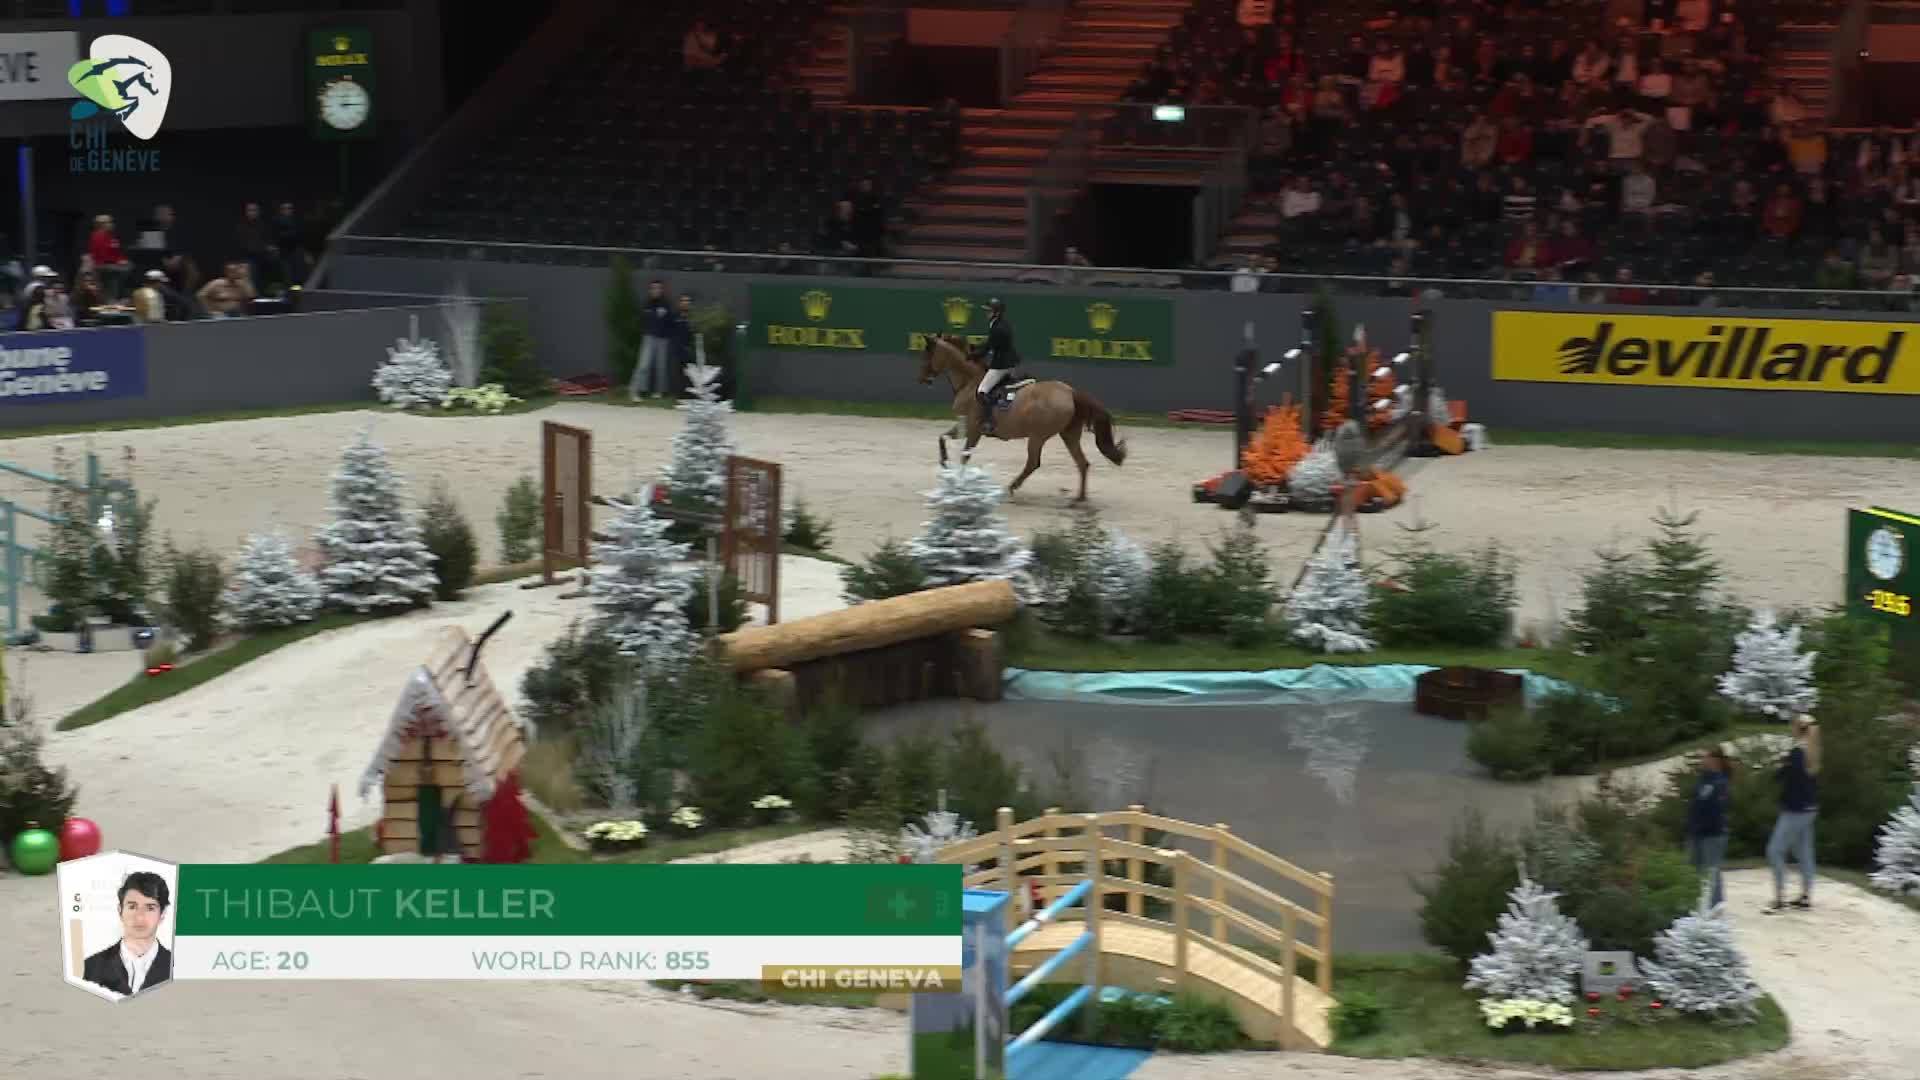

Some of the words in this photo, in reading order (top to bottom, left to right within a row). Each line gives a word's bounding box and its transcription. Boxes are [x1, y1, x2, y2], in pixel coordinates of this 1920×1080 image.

[767, 324, 866, 349] ROLEX
[1050, 337, 1153, 361] ROLEX
[1555, 322, 1905, 384] devillard
